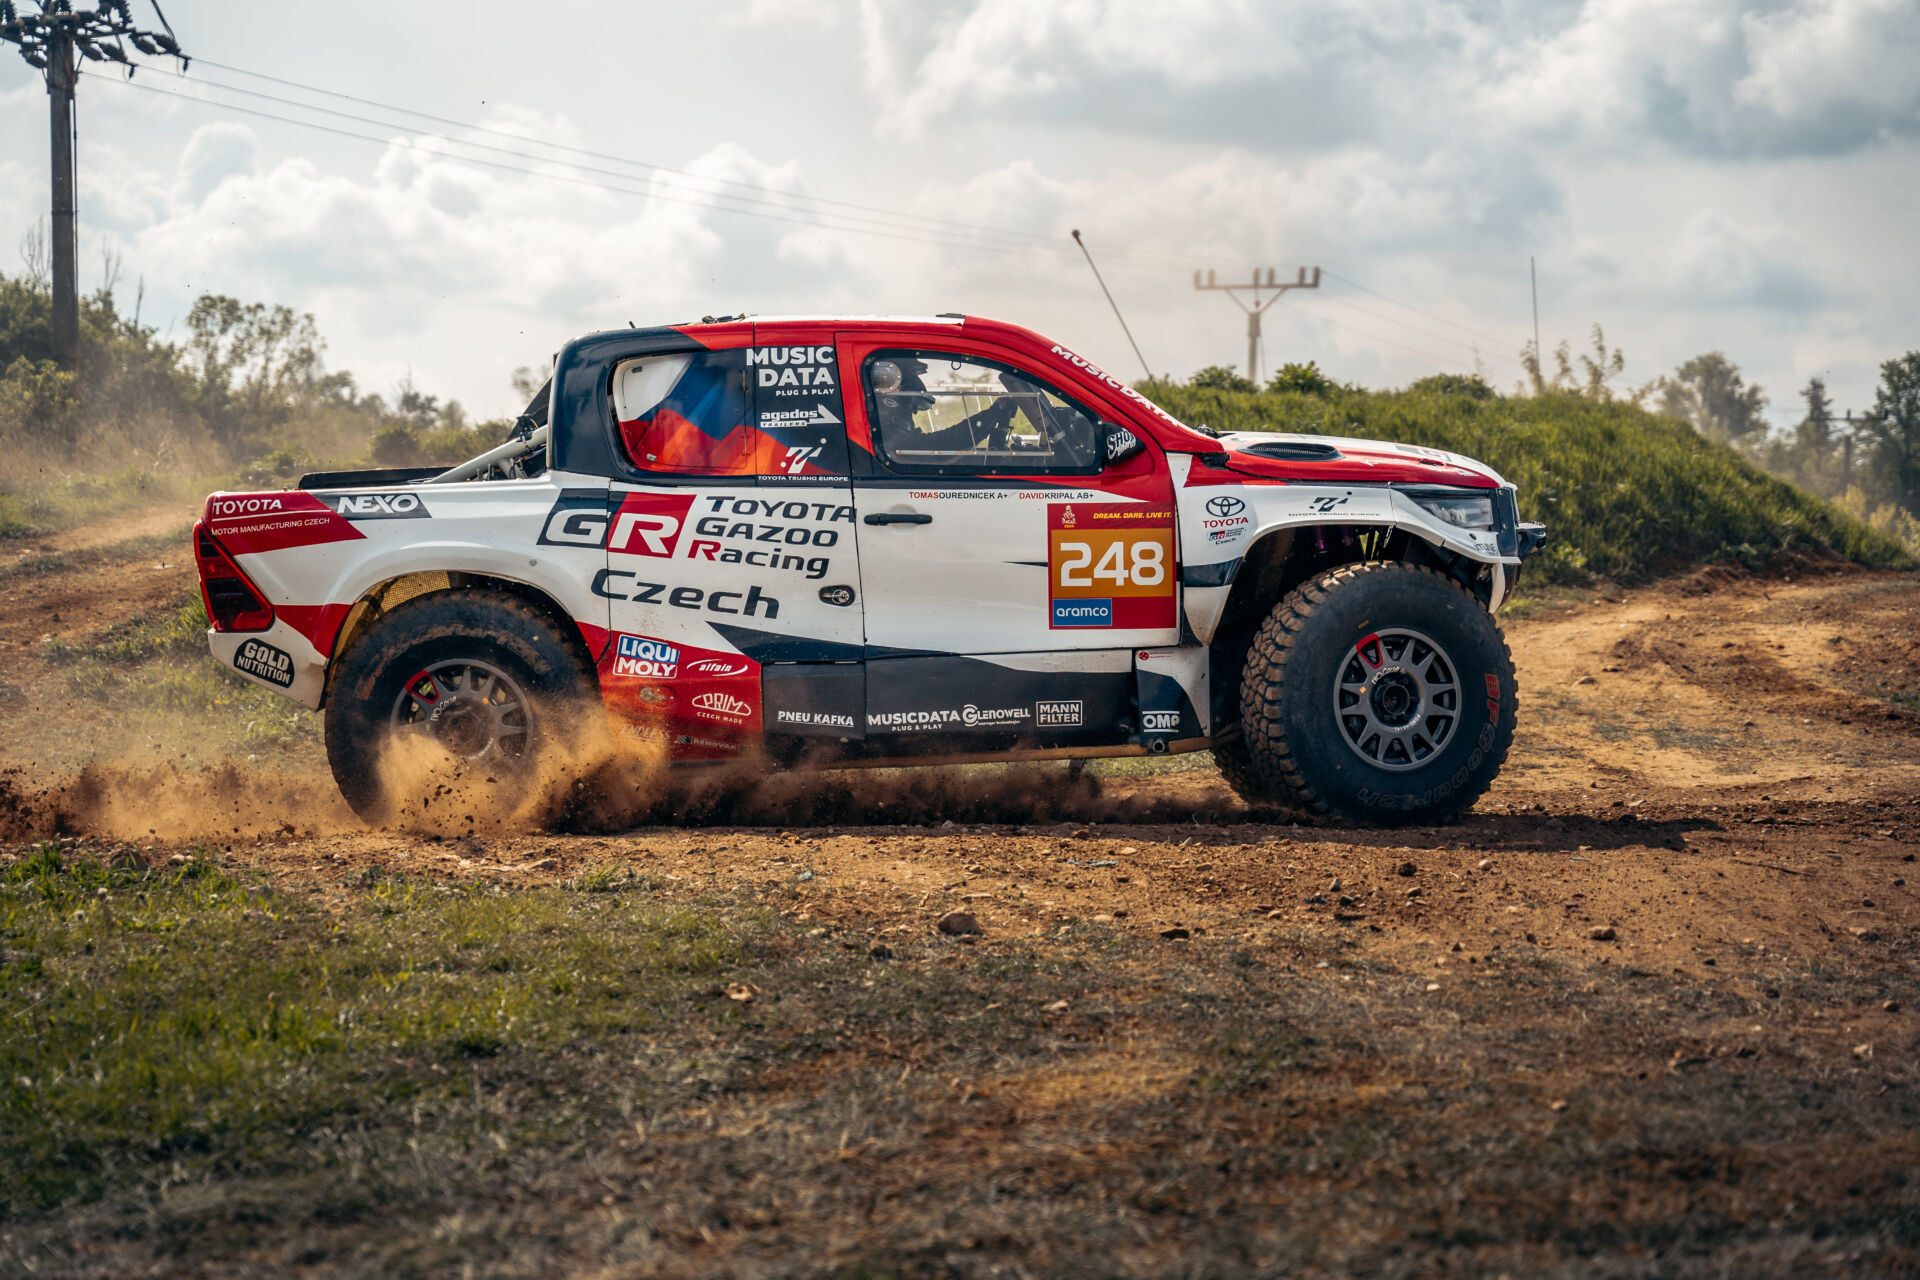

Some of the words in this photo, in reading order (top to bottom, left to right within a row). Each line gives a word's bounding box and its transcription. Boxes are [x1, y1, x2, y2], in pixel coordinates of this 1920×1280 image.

[746, 346, 834, 366] MUSIC
[759, 367, 835, 388] DATA
[1051, 345, 1179, 427] MUSICDATA
[761, 408, 818, 422] agados
[337, 494, 419, 513] NEXO
[997, 491, 1009, 500] A+
[1076, 492, 1095, 500] AB+
[214, 499, 283, 515] TOYOTA
[705, 495, 857, 523] TOYOTA
[1093, 512, 1122, 520] DREAM.
[1146, 511, 1162, 519] LIVE
[1163, 511, 1173, 519] IT.
[212, 526, 239, 536] MOTOR
[240, 519, 303, 533] MANUFACTURING
[304, 517, 330, 527] CZECH
[545, 508, 680, 555] GR
[695, 516, 839, 548] GAZOO
[1202, 516, 1249, 529] TOYOTA
[686, 539, 830, 580] Racing
[1060, 541, 1165, 587] 248
[590, 567, 780, 620] Czech
[1056, 607, 1109, 617] aramco
[244, 642, 290, 671] GOLD
[620, 637, 677, 662] LIQUI
[237, 655, 291, 684] NUTRITION
[617, 656, 677, 677] MOLY
[702, 692, 744, 713] PRIM
[1040, 703, 1080, 713] MANN
[696, 711, 721, 720] CZECH
[722, 716, 743, 725] MADE
[777, 710, 811, 723] PNEU
[813, 713, 854, 726] KAFKA
[867, 710, 961, 726] MUSICDATA
[1040, 713, 1080, 723] FILTER
[1143, 714, 1180, 729] OMP
